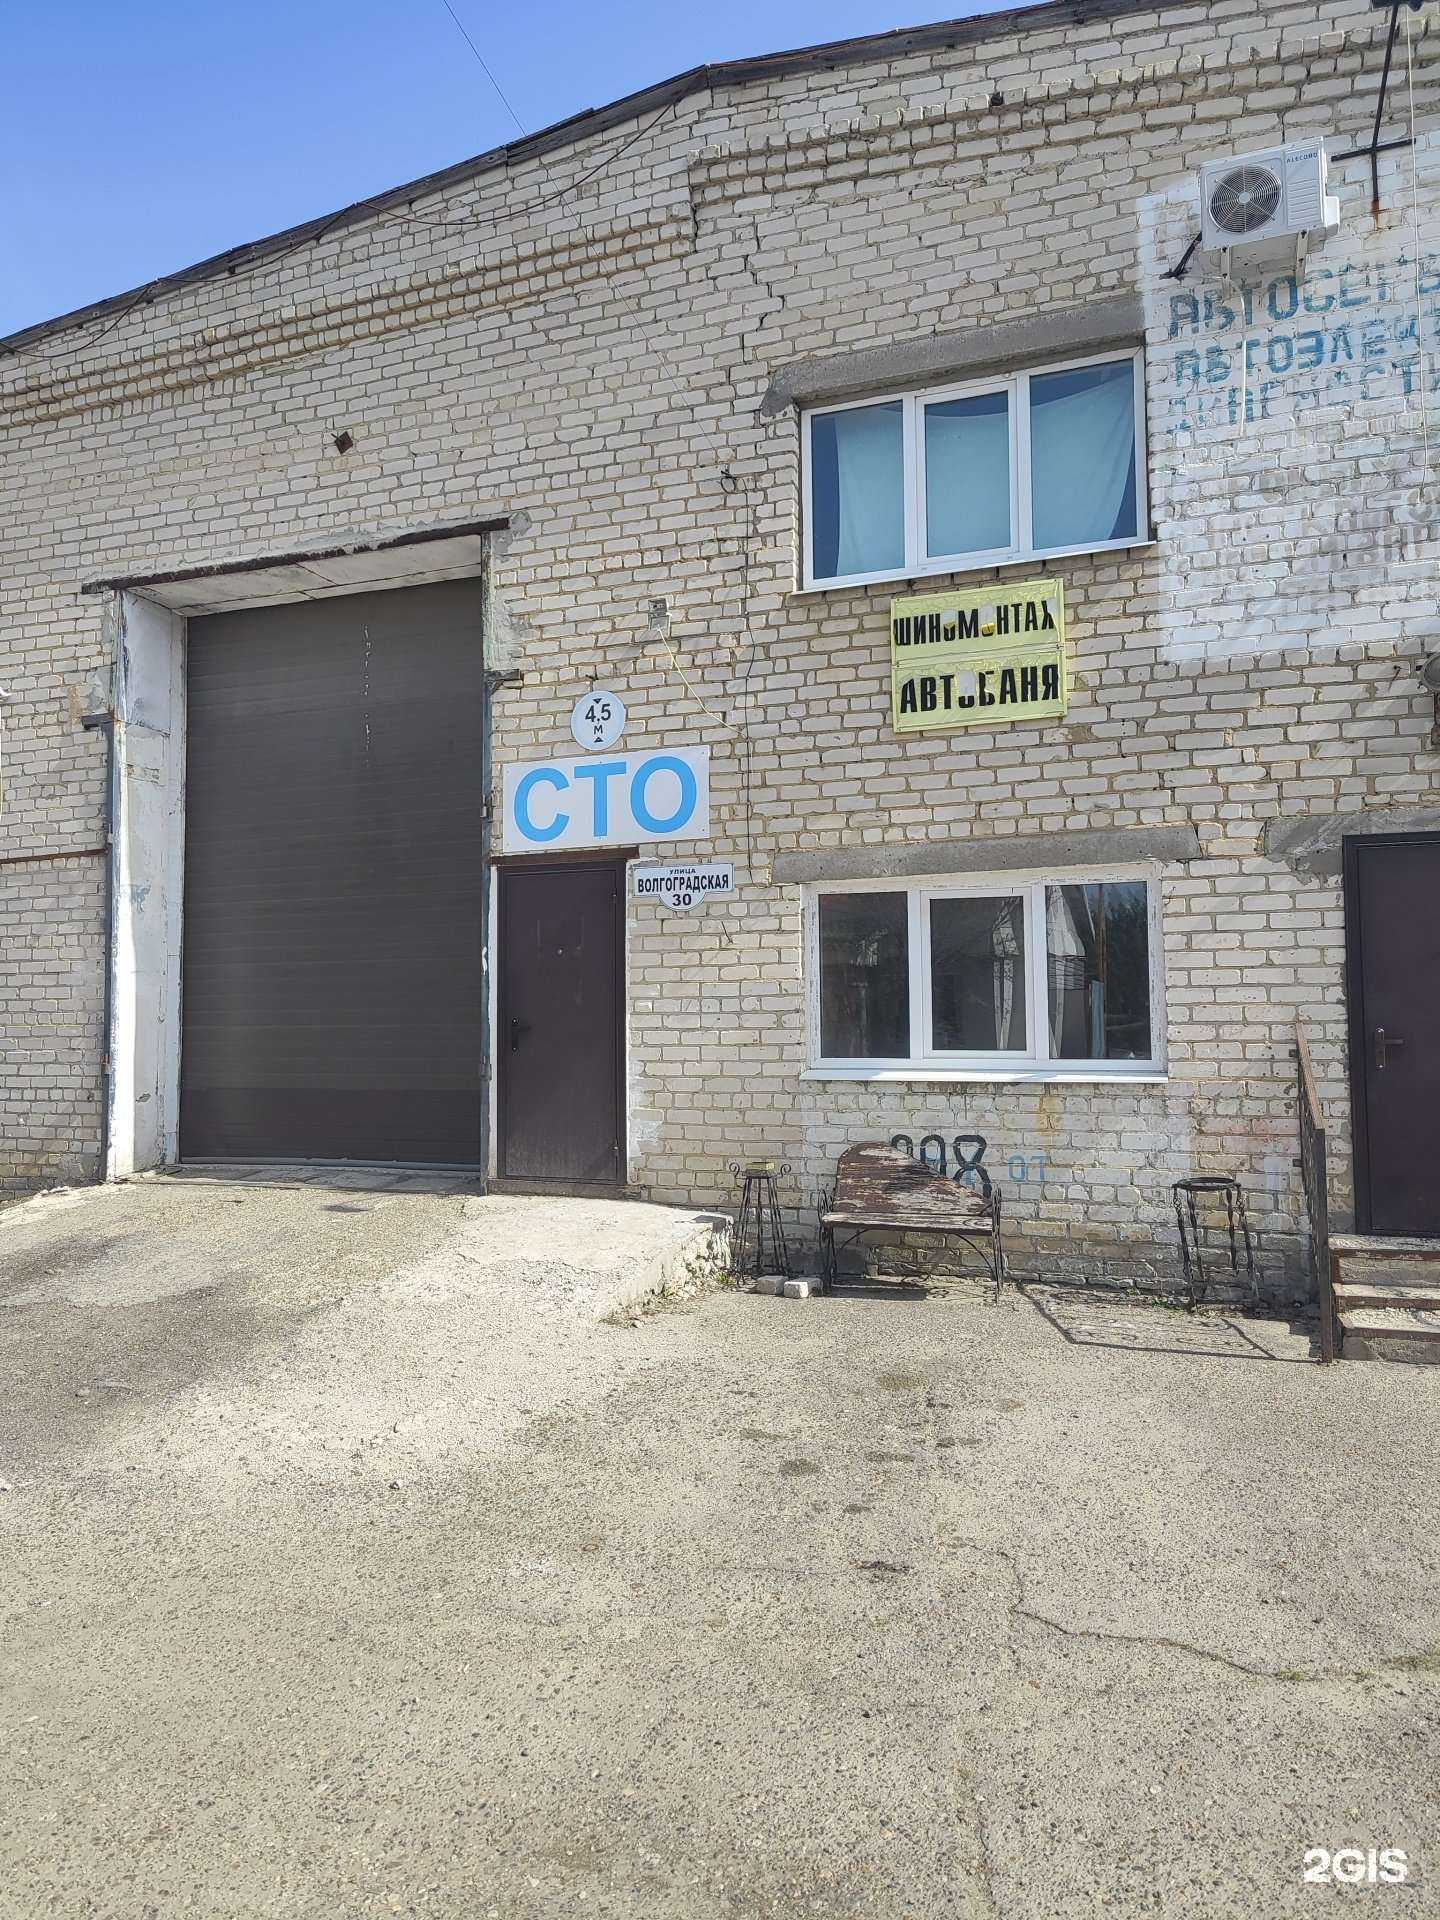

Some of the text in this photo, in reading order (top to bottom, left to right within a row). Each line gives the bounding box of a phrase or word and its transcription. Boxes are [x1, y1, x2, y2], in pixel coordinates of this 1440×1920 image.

[513, 756, 698, 842] СТО
[638, 874, 729, 893] ВОЛГОГРАДСКАЯ
[672, 893, 692, 906] 30
